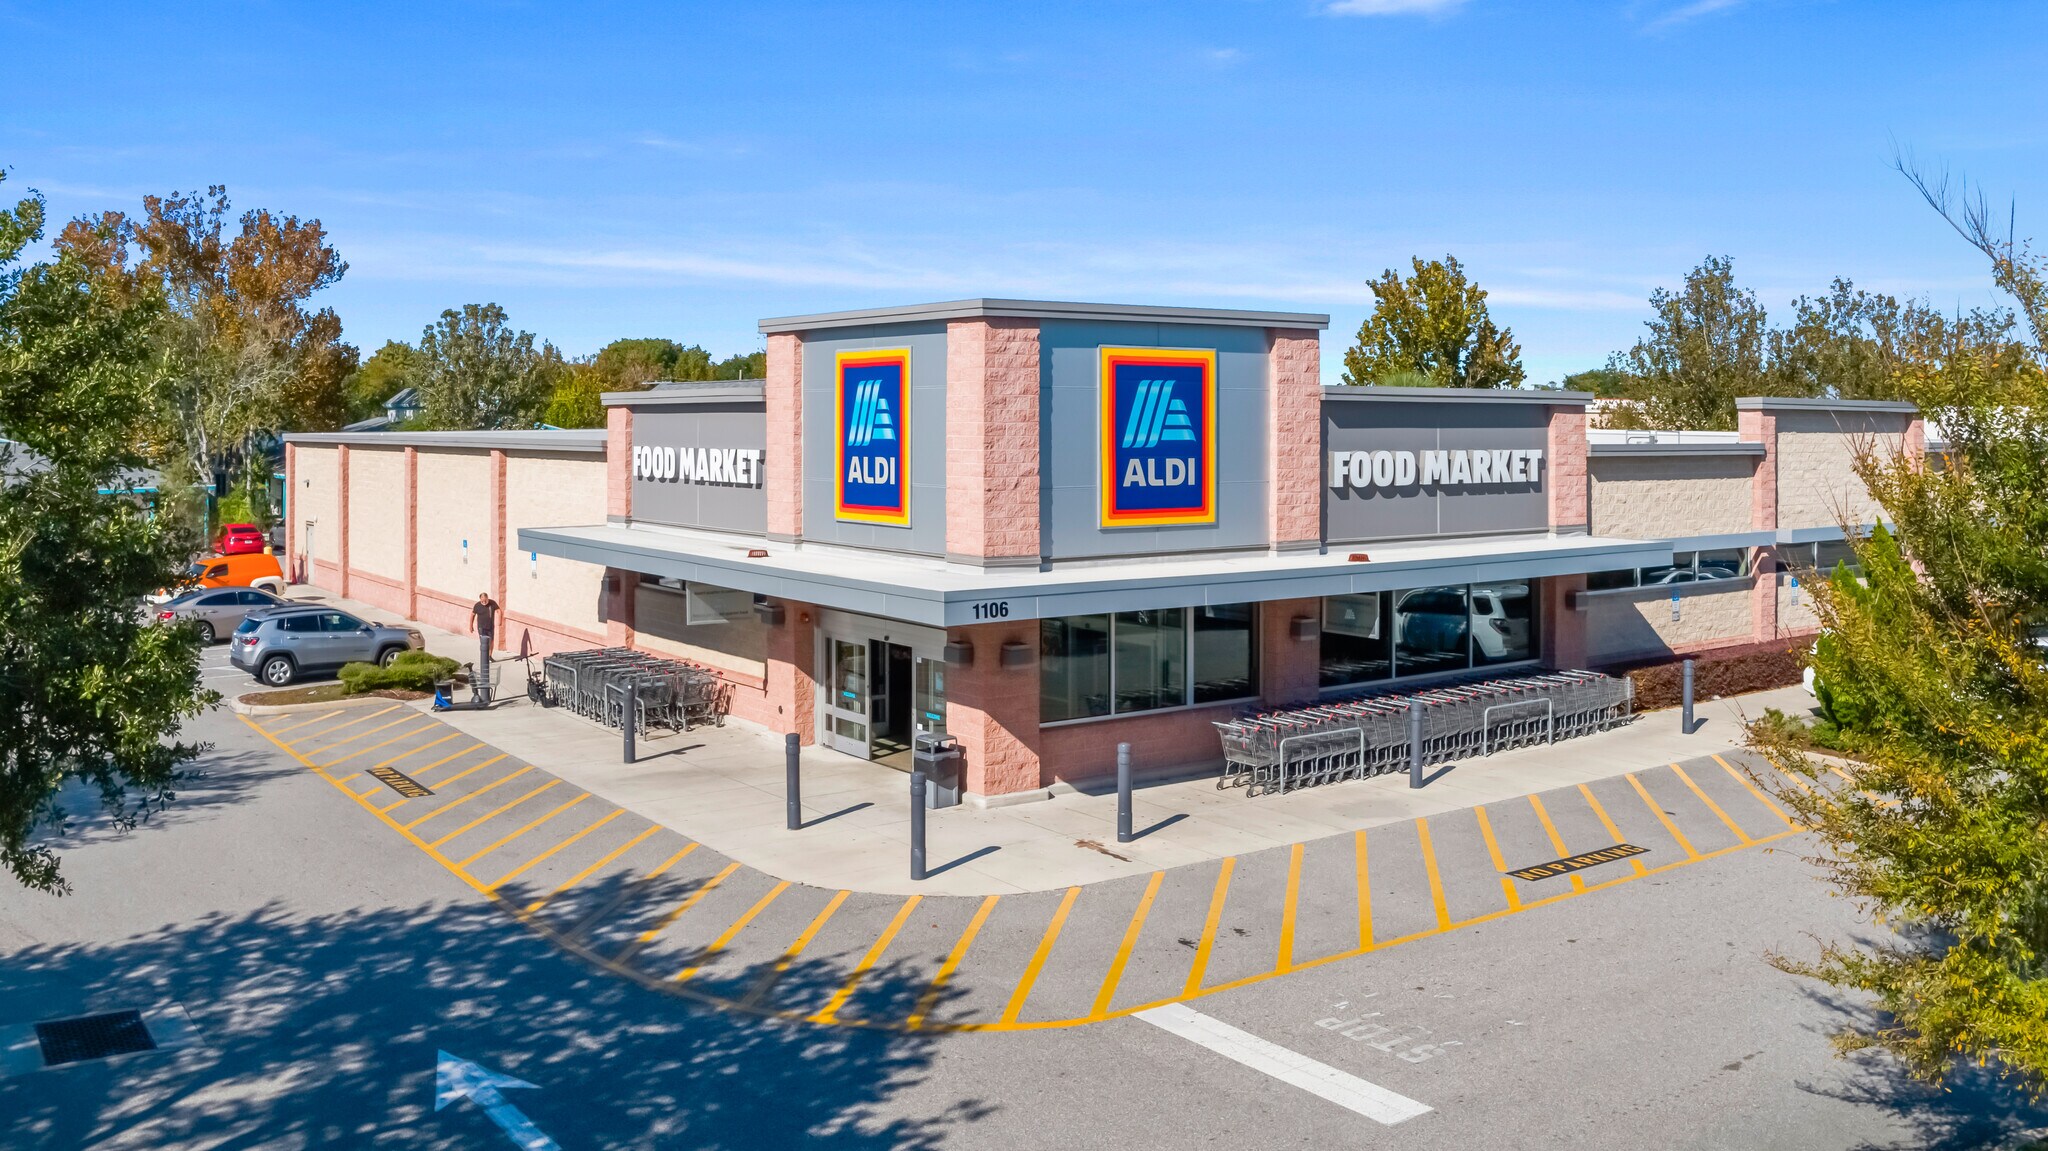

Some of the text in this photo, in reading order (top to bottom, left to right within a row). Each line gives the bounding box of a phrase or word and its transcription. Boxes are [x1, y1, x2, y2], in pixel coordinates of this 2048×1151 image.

[633, 445, 761, 485] FOOD MARKET
[847, 455, 896, 485] ALDI
[1122, 457, 1197, 488] ALDI
[1331, 449, 1543, 488] FOOD MARKET
[972, 601, 1009, 619] 1106
[1513, 845, 1645, 881] NO PARKING
